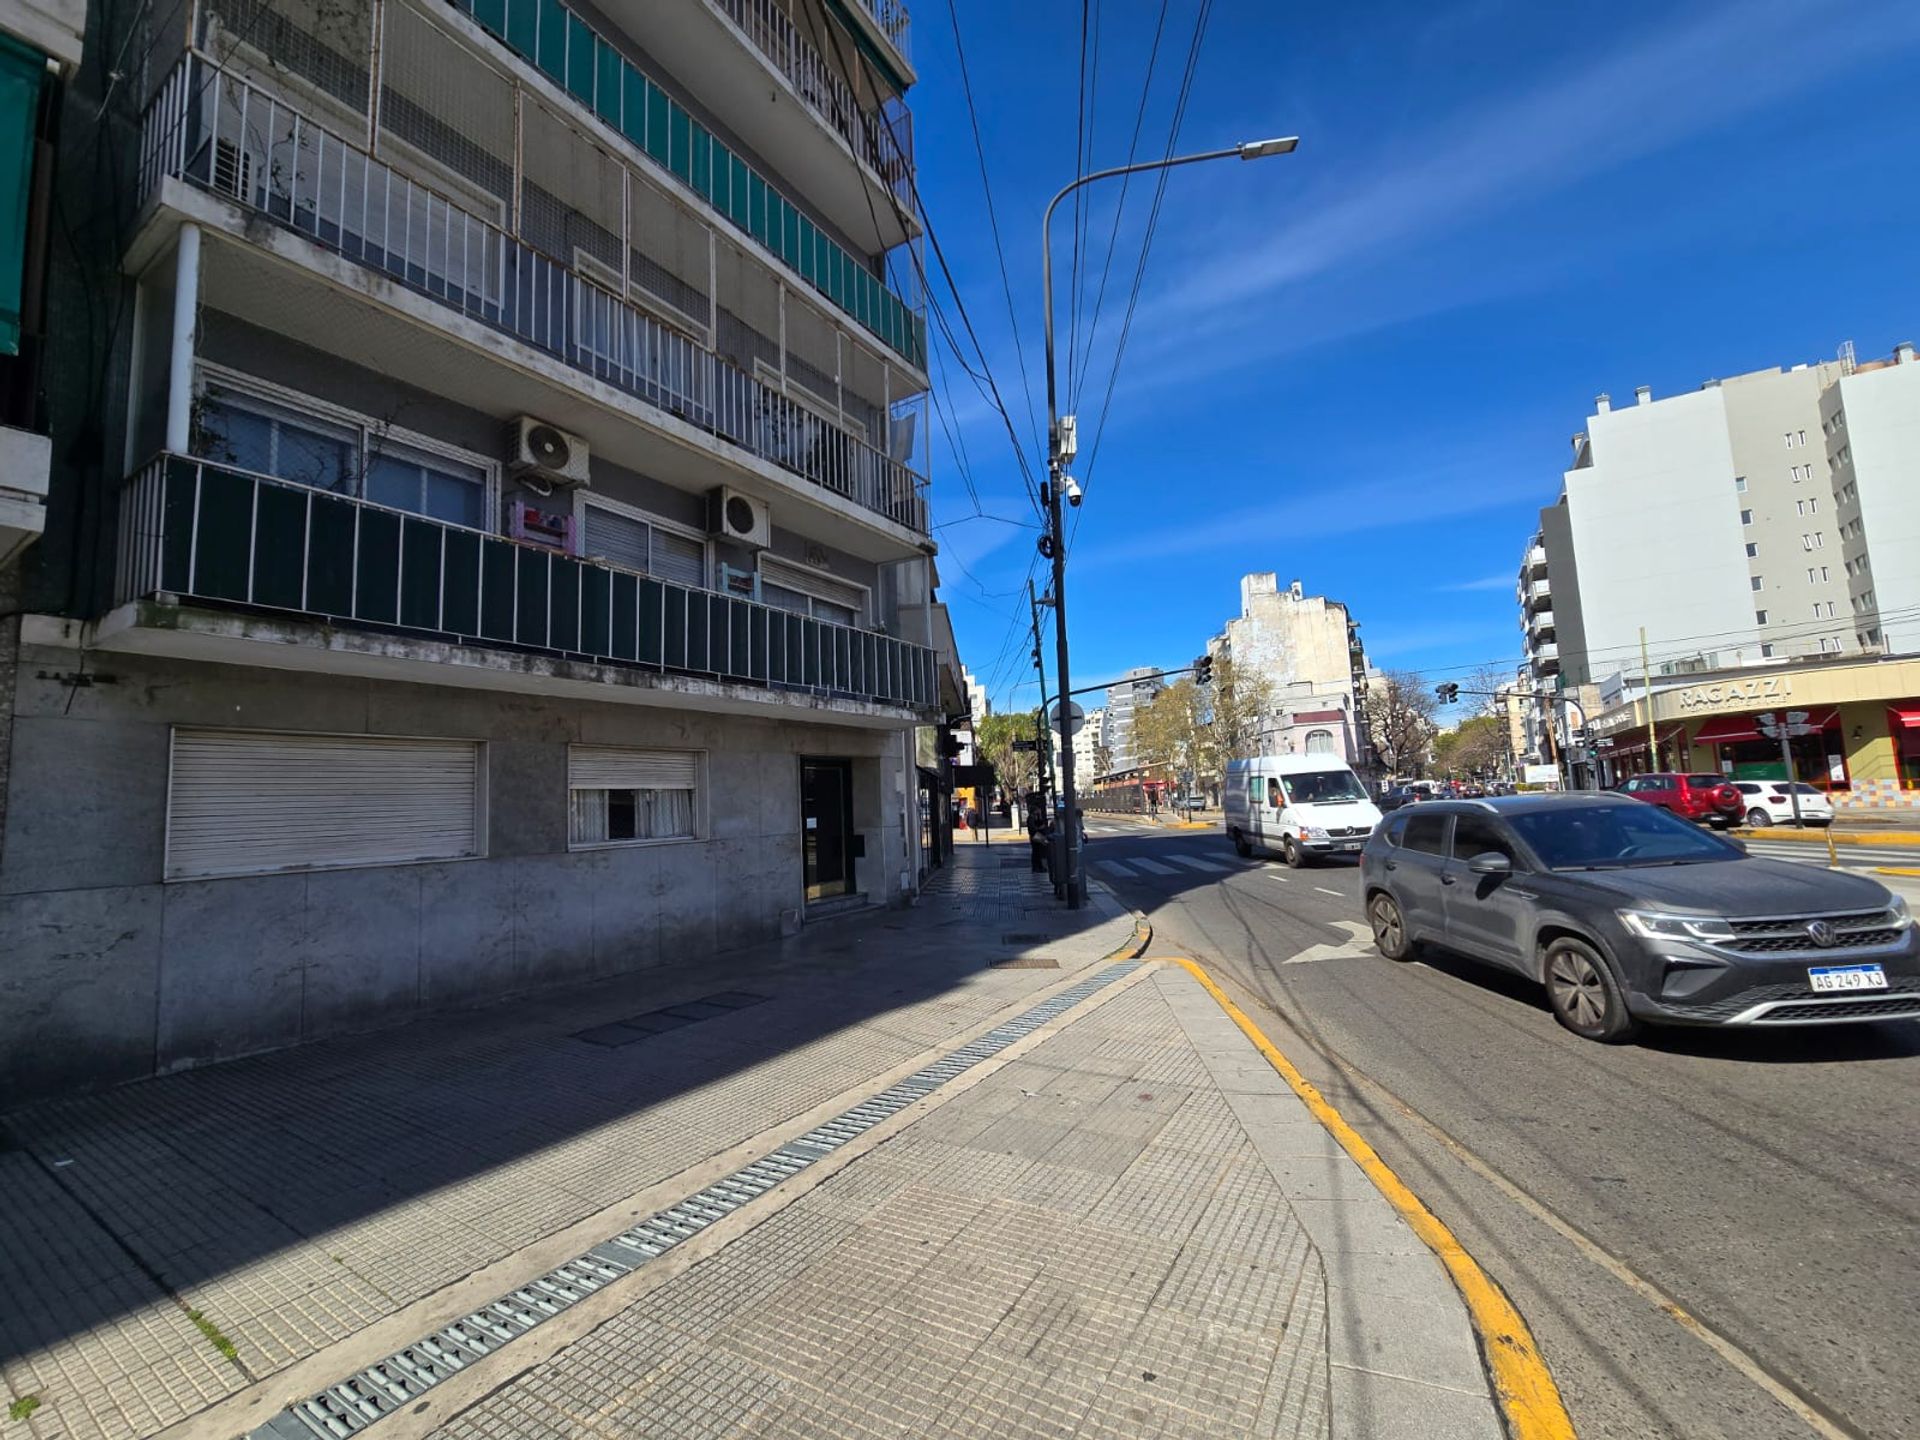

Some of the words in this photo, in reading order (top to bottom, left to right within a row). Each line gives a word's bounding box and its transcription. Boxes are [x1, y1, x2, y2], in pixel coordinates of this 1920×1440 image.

[1680, 676, 1792, 708] RAGAZZI
[1816, 975, 1833, 989] AG
[1836, 973, 1861, 988] 249
